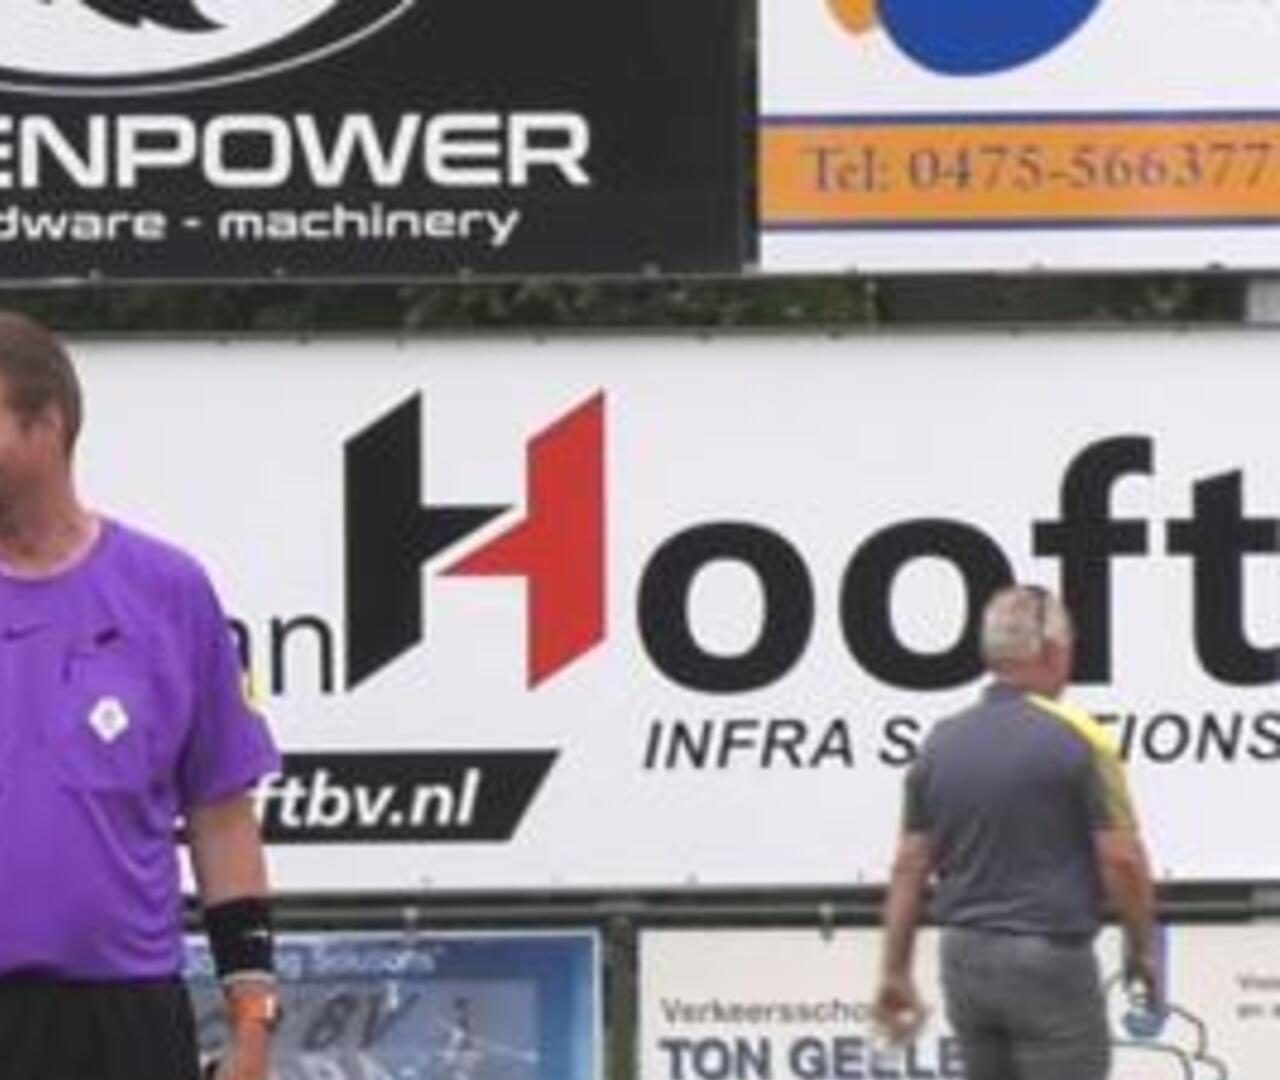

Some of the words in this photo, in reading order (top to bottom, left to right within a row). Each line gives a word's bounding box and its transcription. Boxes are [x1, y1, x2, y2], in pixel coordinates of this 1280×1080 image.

[805, 145, 888, 193] Tel:
[907, 142, 1275, 192] 0475-566377
[217, 203, 520, 246] machinery
[643, 718, 855, 770] INFRA
[877, 711, 1280, 768] SIONS
[250, 768, 482, 827] ftbv.nl
